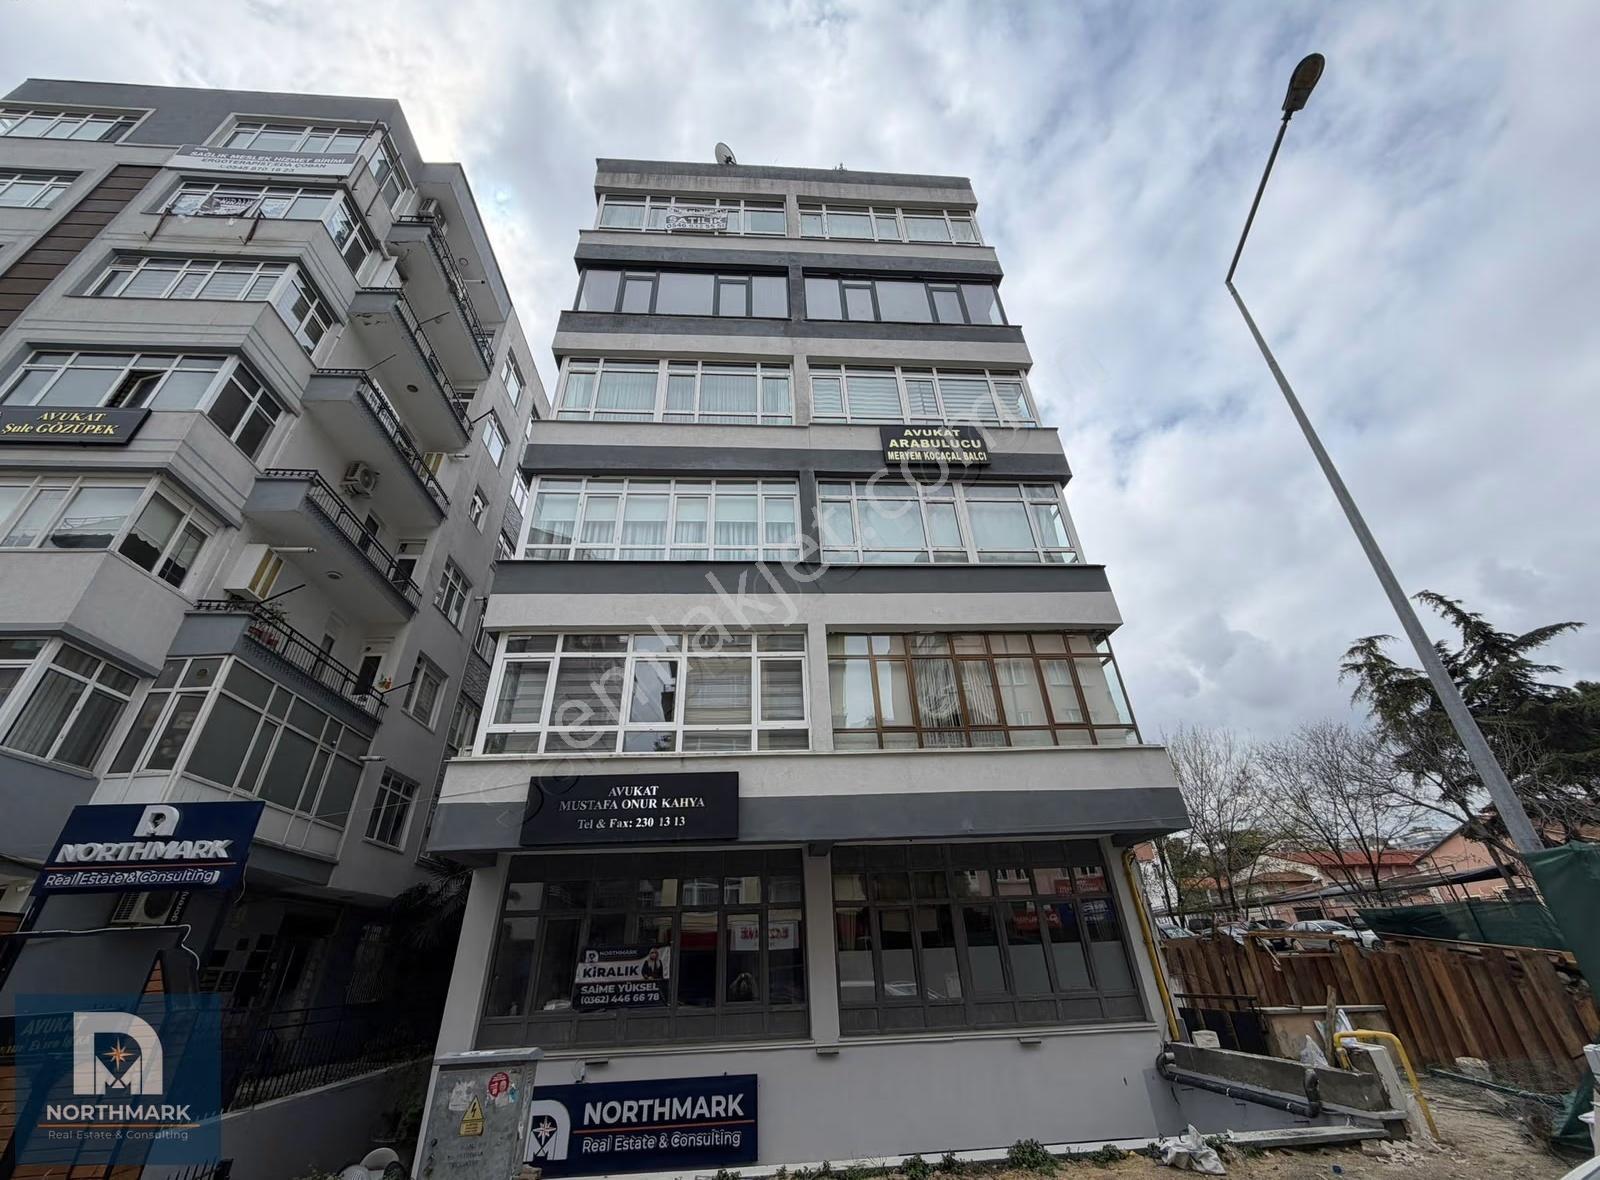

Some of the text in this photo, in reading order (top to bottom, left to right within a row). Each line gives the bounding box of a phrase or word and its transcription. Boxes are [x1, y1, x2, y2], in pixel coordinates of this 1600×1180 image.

[37, 412, 106, 422] AVUKAT
[2, 422, 119, 435] Şule GÖZÜPEK
[903, 429, 960, 437] AVUKAT
[889, 438, 981, 449] ARABULUCU
[887, 451, 921, 461] MERYEM
[962, 451, 987, 461] BALCI
[608, 785, 660, 797] AVUKAT
[559, 797, 705, 812] MUSTAFA ONUR KAHYA
[577, 816, 687, 830] Tel & Fax: 230 13 13
[54, 839, 233, 863] NORTHMARK
[44, 868, 220, 887] Real Estate & Consulting
[170, 889, 191, 922] gorenj
[583, 965, 639, 978] KİRALIK
[618, 982, 660, 993] YÜKSEL
[580, 995, 610, 1005] (0362)
[610, 994, 631, 1004] 446
[647, 993, 661, 1002] 78
[582, 1093, 745, 1126] NORTHMARK
[583, 1129, 742, 1152] Real Estate & Consulting
